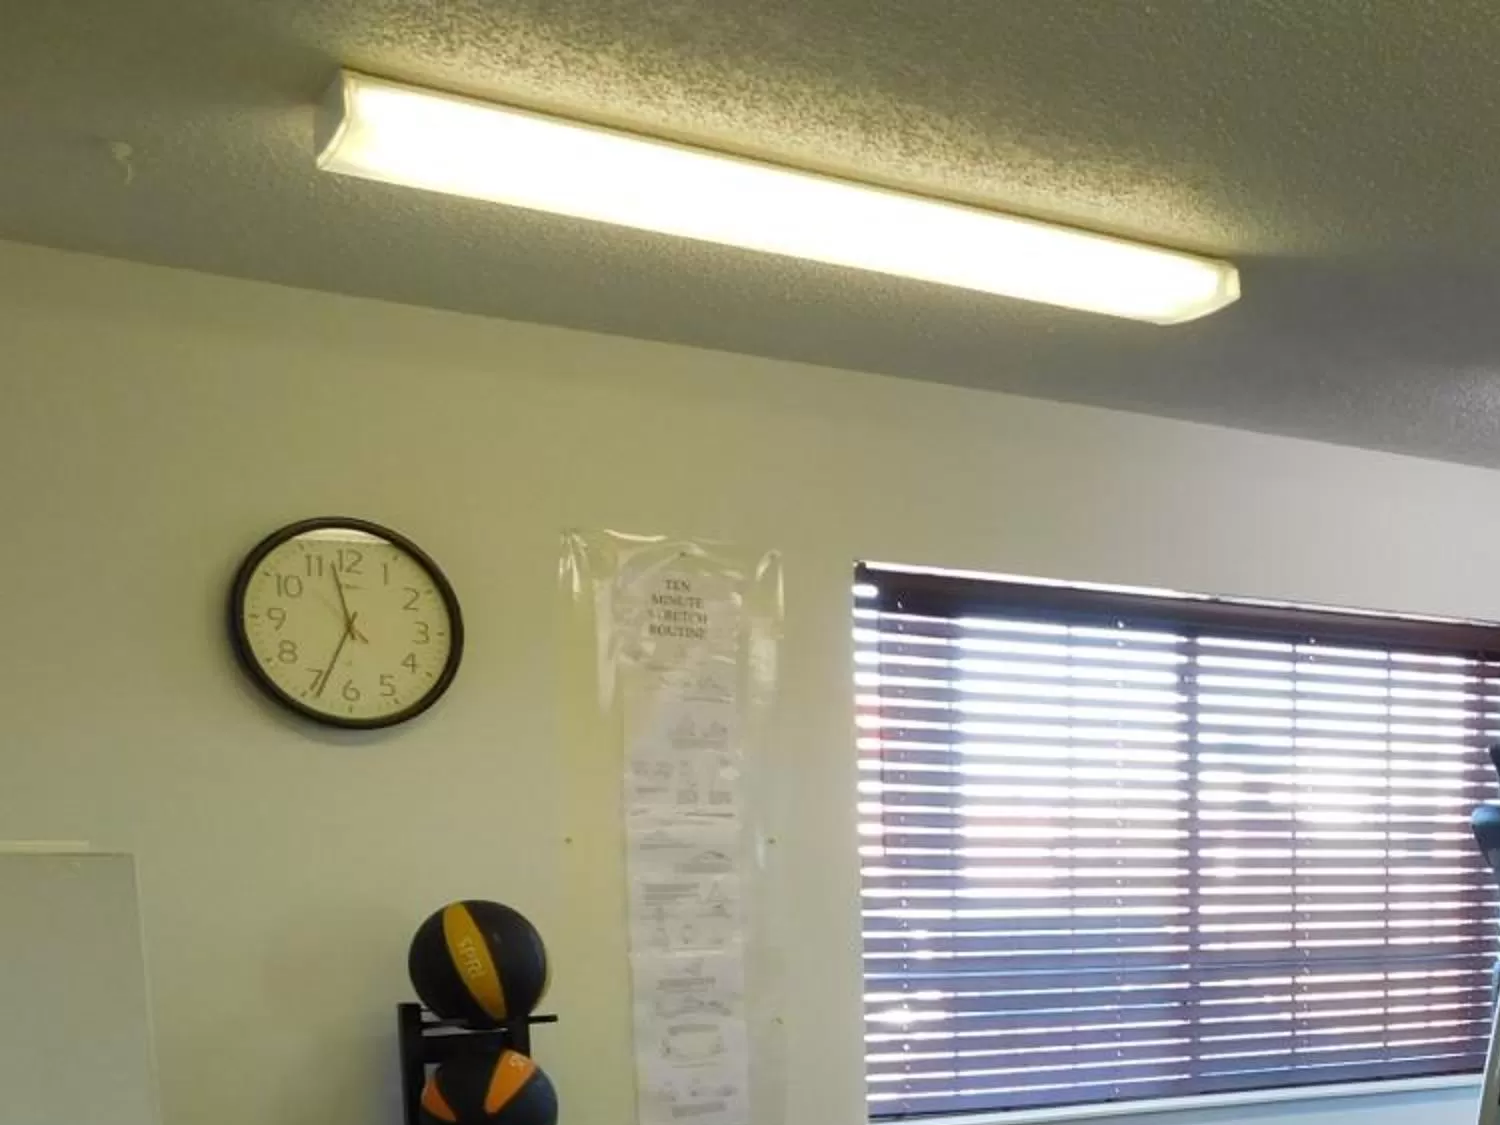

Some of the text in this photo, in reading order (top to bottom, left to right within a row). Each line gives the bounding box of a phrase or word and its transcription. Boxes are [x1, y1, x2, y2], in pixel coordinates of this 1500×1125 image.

[304, 554, 324, 577] 11
[336, 549, 364, 575] 12
[382, 562, 389, 586] 1
[275, 574, 303, 599] 10
[402, 586, 420, 611] 2
[266, 606, 287, 631] 9
[413, 621, 429, 645] 3
[277, 639, 298, 664] 8
[401, 652, 420, 673] 4
[306, 668, 323, 691] 7
[342, 679, 361, 702] 6
[379, 674, 396, 697] 5
